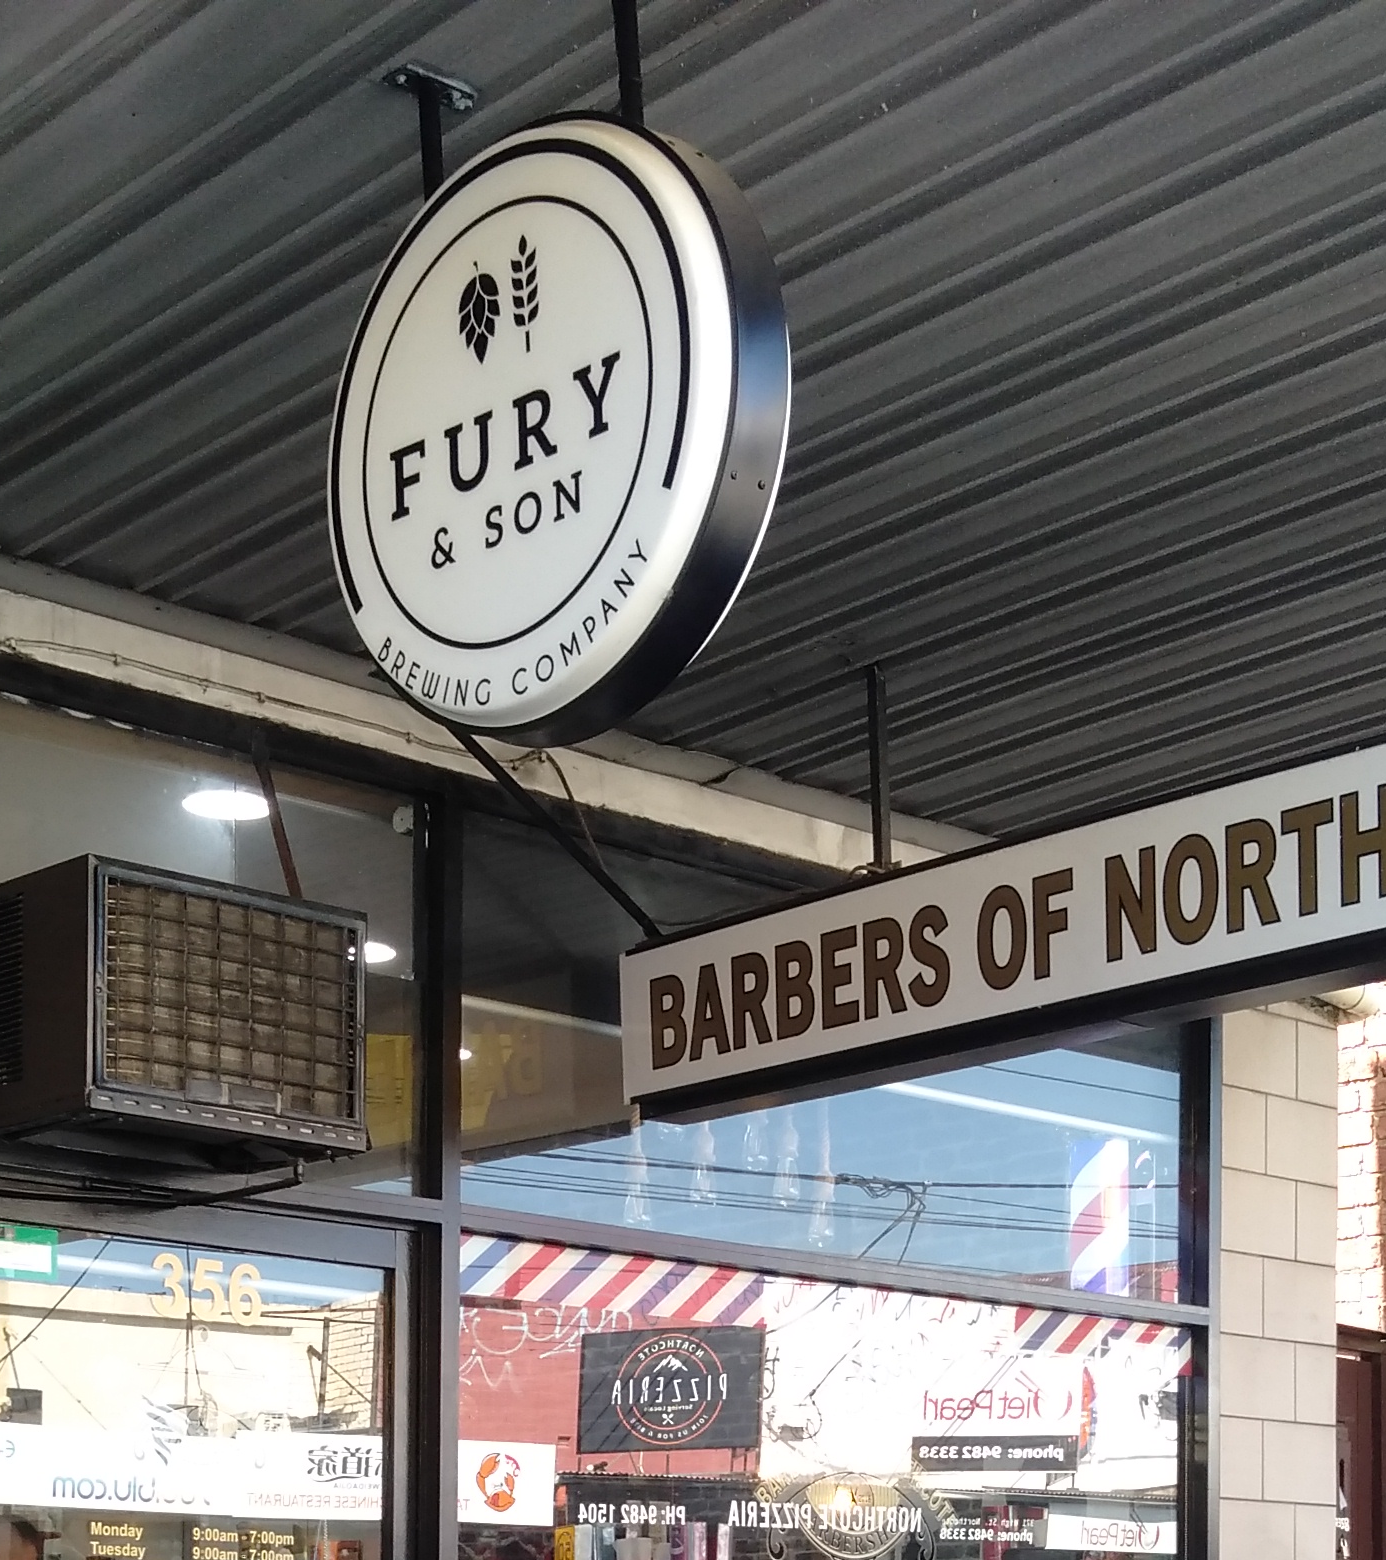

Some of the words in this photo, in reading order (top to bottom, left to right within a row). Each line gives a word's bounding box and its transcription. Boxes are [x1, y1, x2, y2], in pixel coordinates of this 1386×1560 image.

[389, 351, 620, 522] FURY
[430, 526, 455, 569] &
[484, 471, 583, 550] SON
[377, 636, 492, 707] BREWING
[511, 539, 649, 696] COMPANY
[649, 901, 951, 1070] BARBERS
[976, 867, 1074, 990] OF
[151, 1253, 263, 1326] 356
[90, 1522, 143, 1541] Monday
[193, 1528, 238, 1542] 9:00am
[250, 1531, 294, 1546] 7:00pm
[90, 1542, 145, 1560] Tuesday
